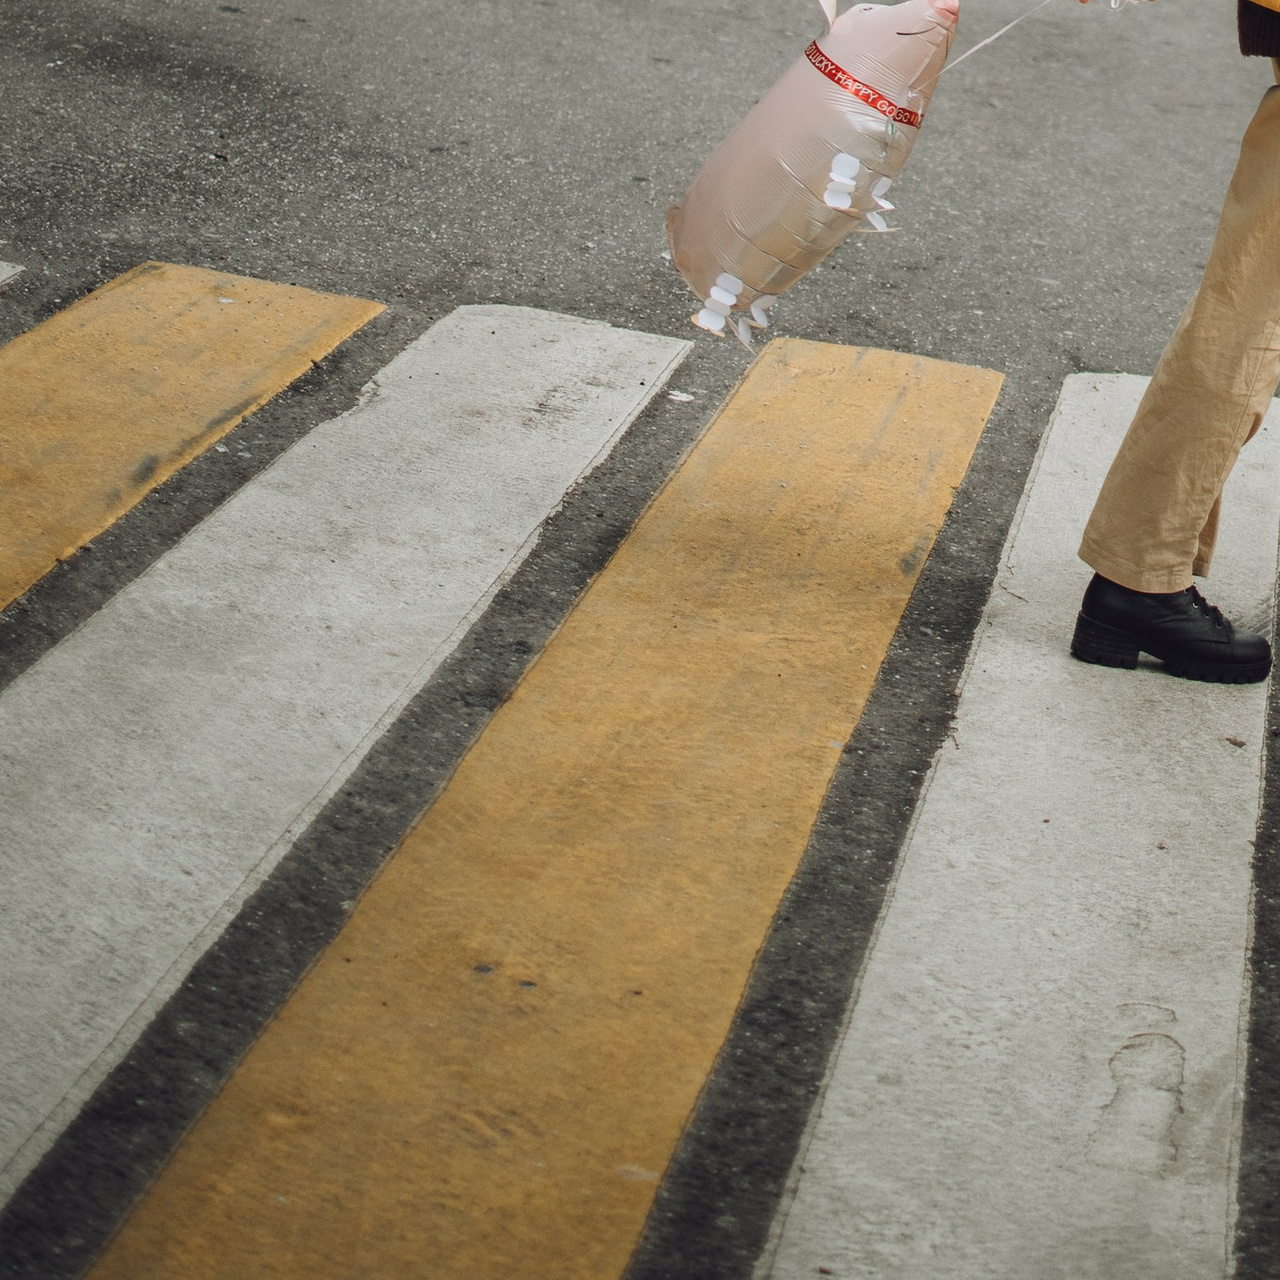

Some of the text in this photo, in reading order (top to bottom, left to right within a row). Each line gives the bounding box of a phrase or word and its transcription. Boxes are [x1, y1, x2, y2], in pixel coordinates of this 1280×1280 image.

[809, 50, 836, 73] LUCKY
[835, 71, 879, 103] HAPPY
[876, 100, 896, 117] GO
